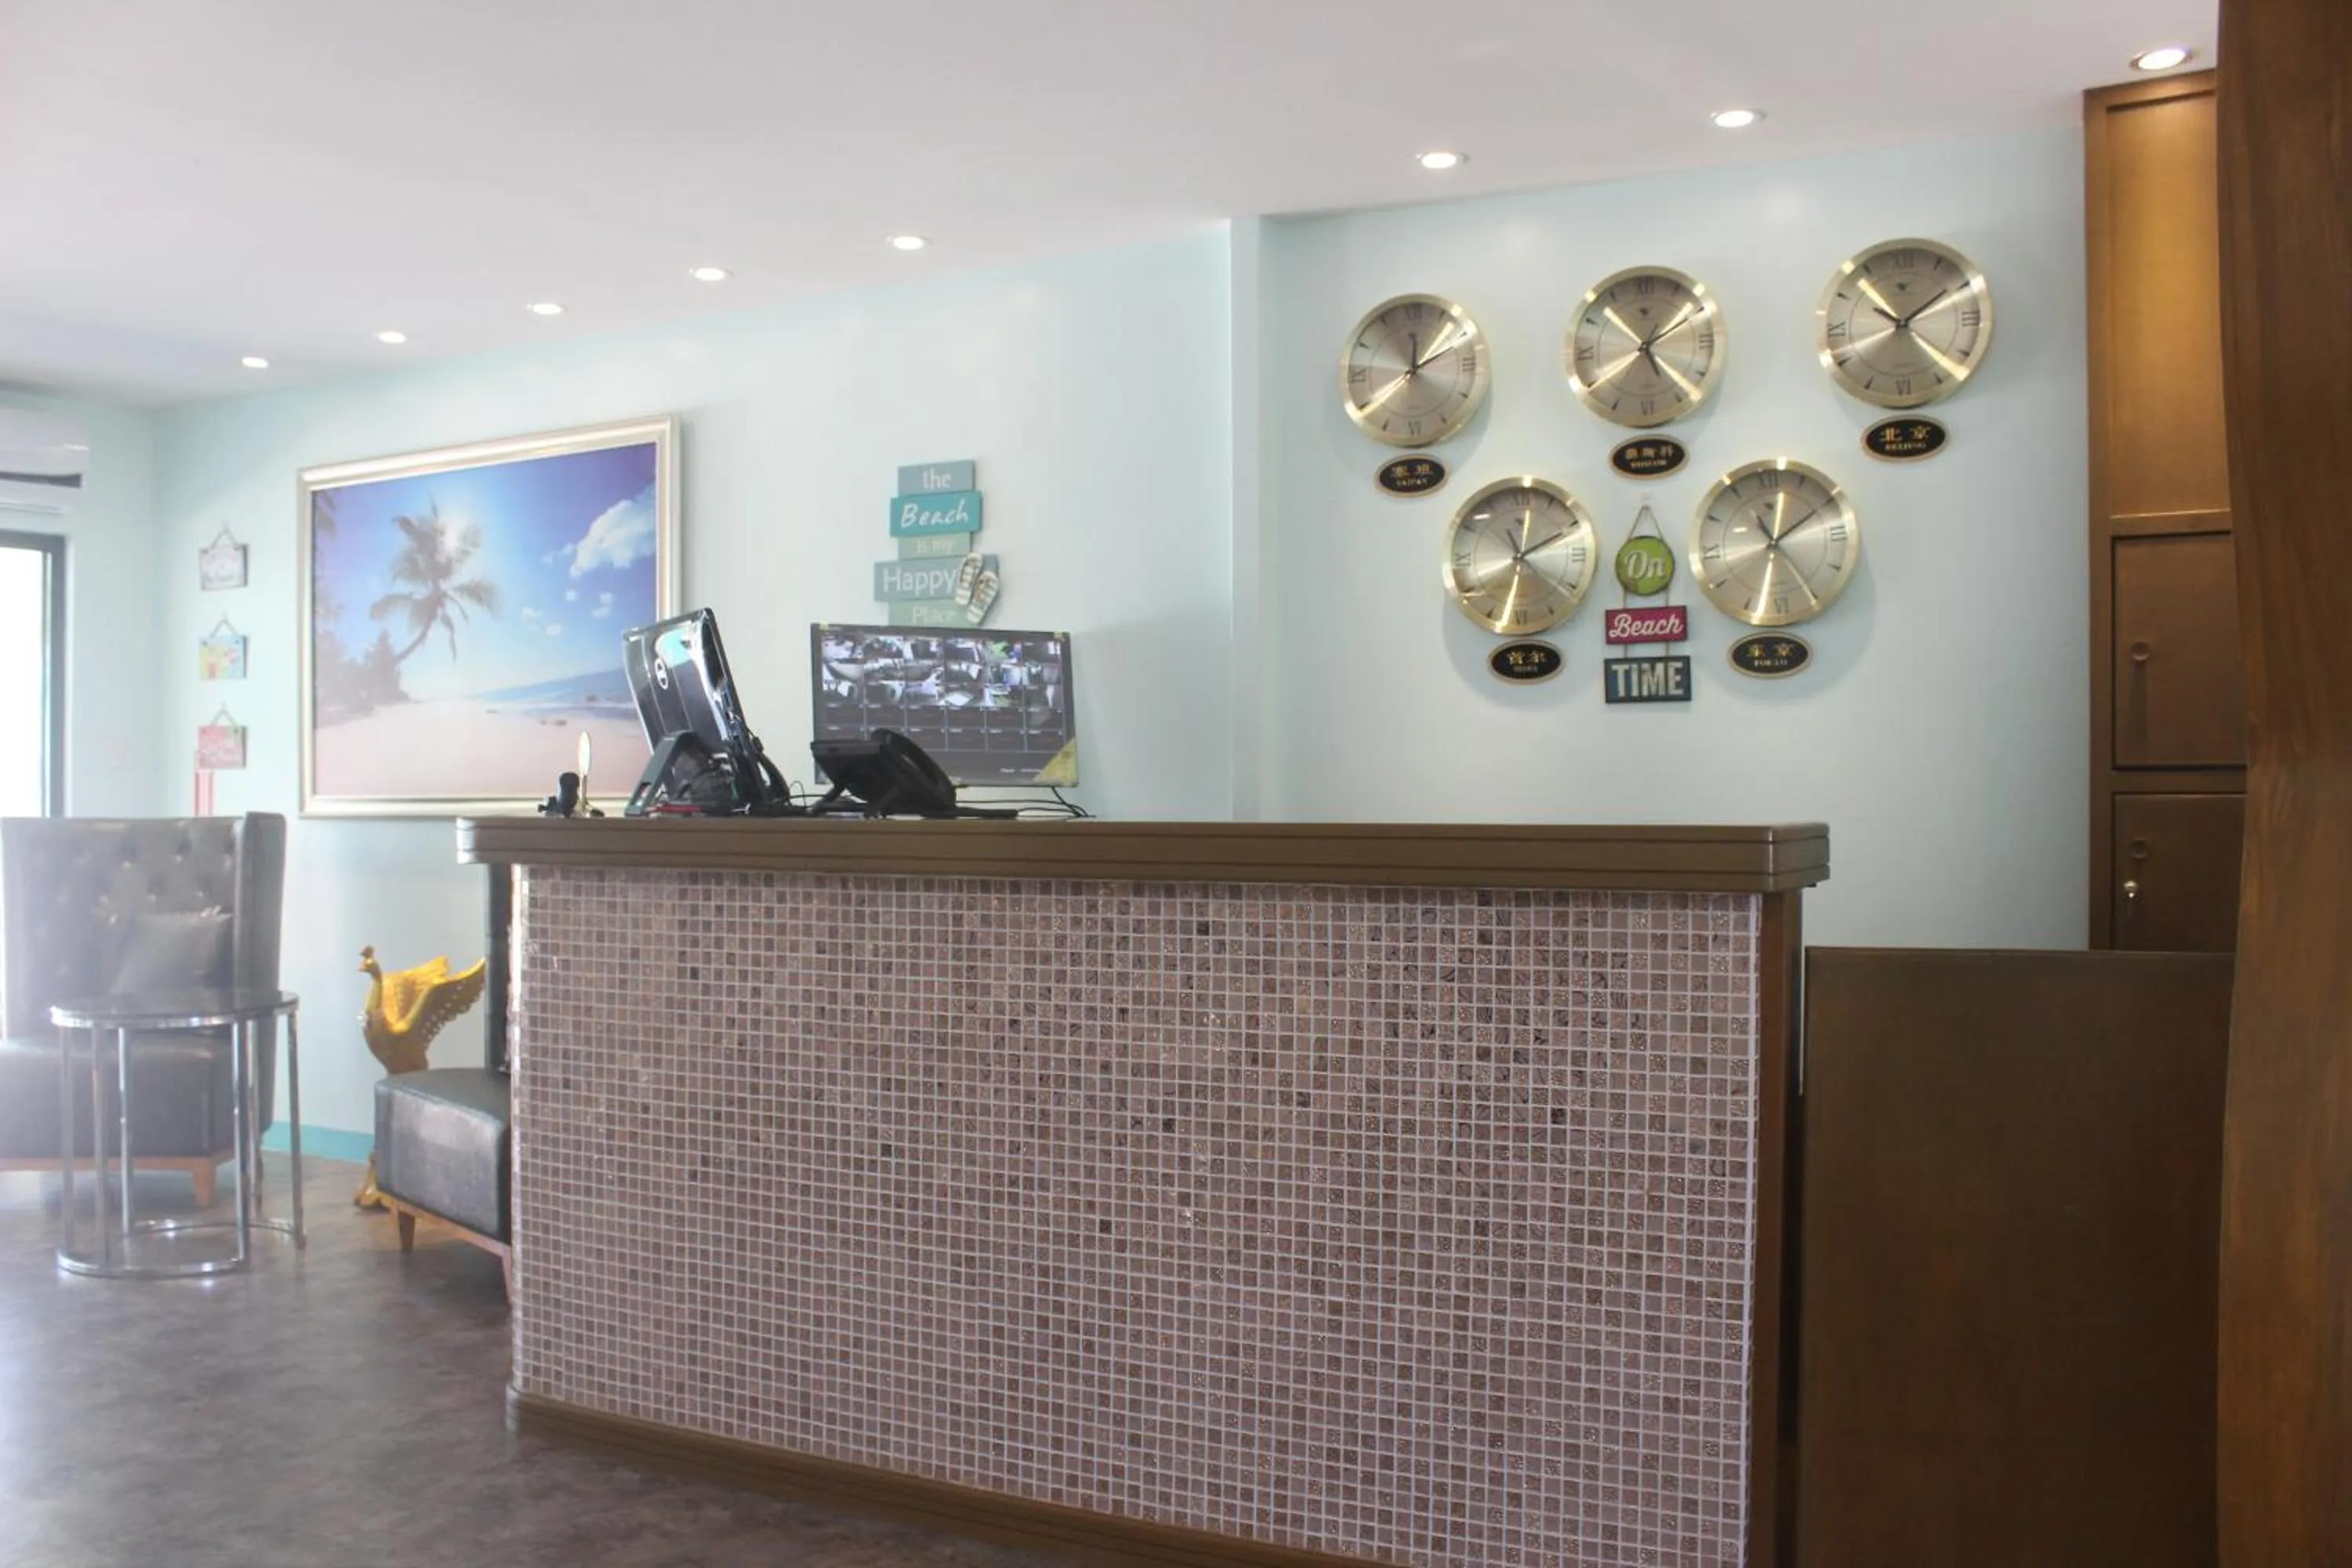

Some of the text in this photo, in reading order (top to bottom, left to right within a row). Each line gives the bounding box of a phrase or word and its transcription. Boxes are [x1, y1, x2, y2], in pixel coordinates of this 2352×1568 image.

[1878, 426, 1932, 442] 北京
[923, 468, 952, 489] the
[901, 498, 969, 528] Beach
[1624, 551, 1664, 579] On
[883, 566, 957, 596] Happy
[1610, 614, 1684, 637] Beach
[1612, 662, 1683, 697] TIME
